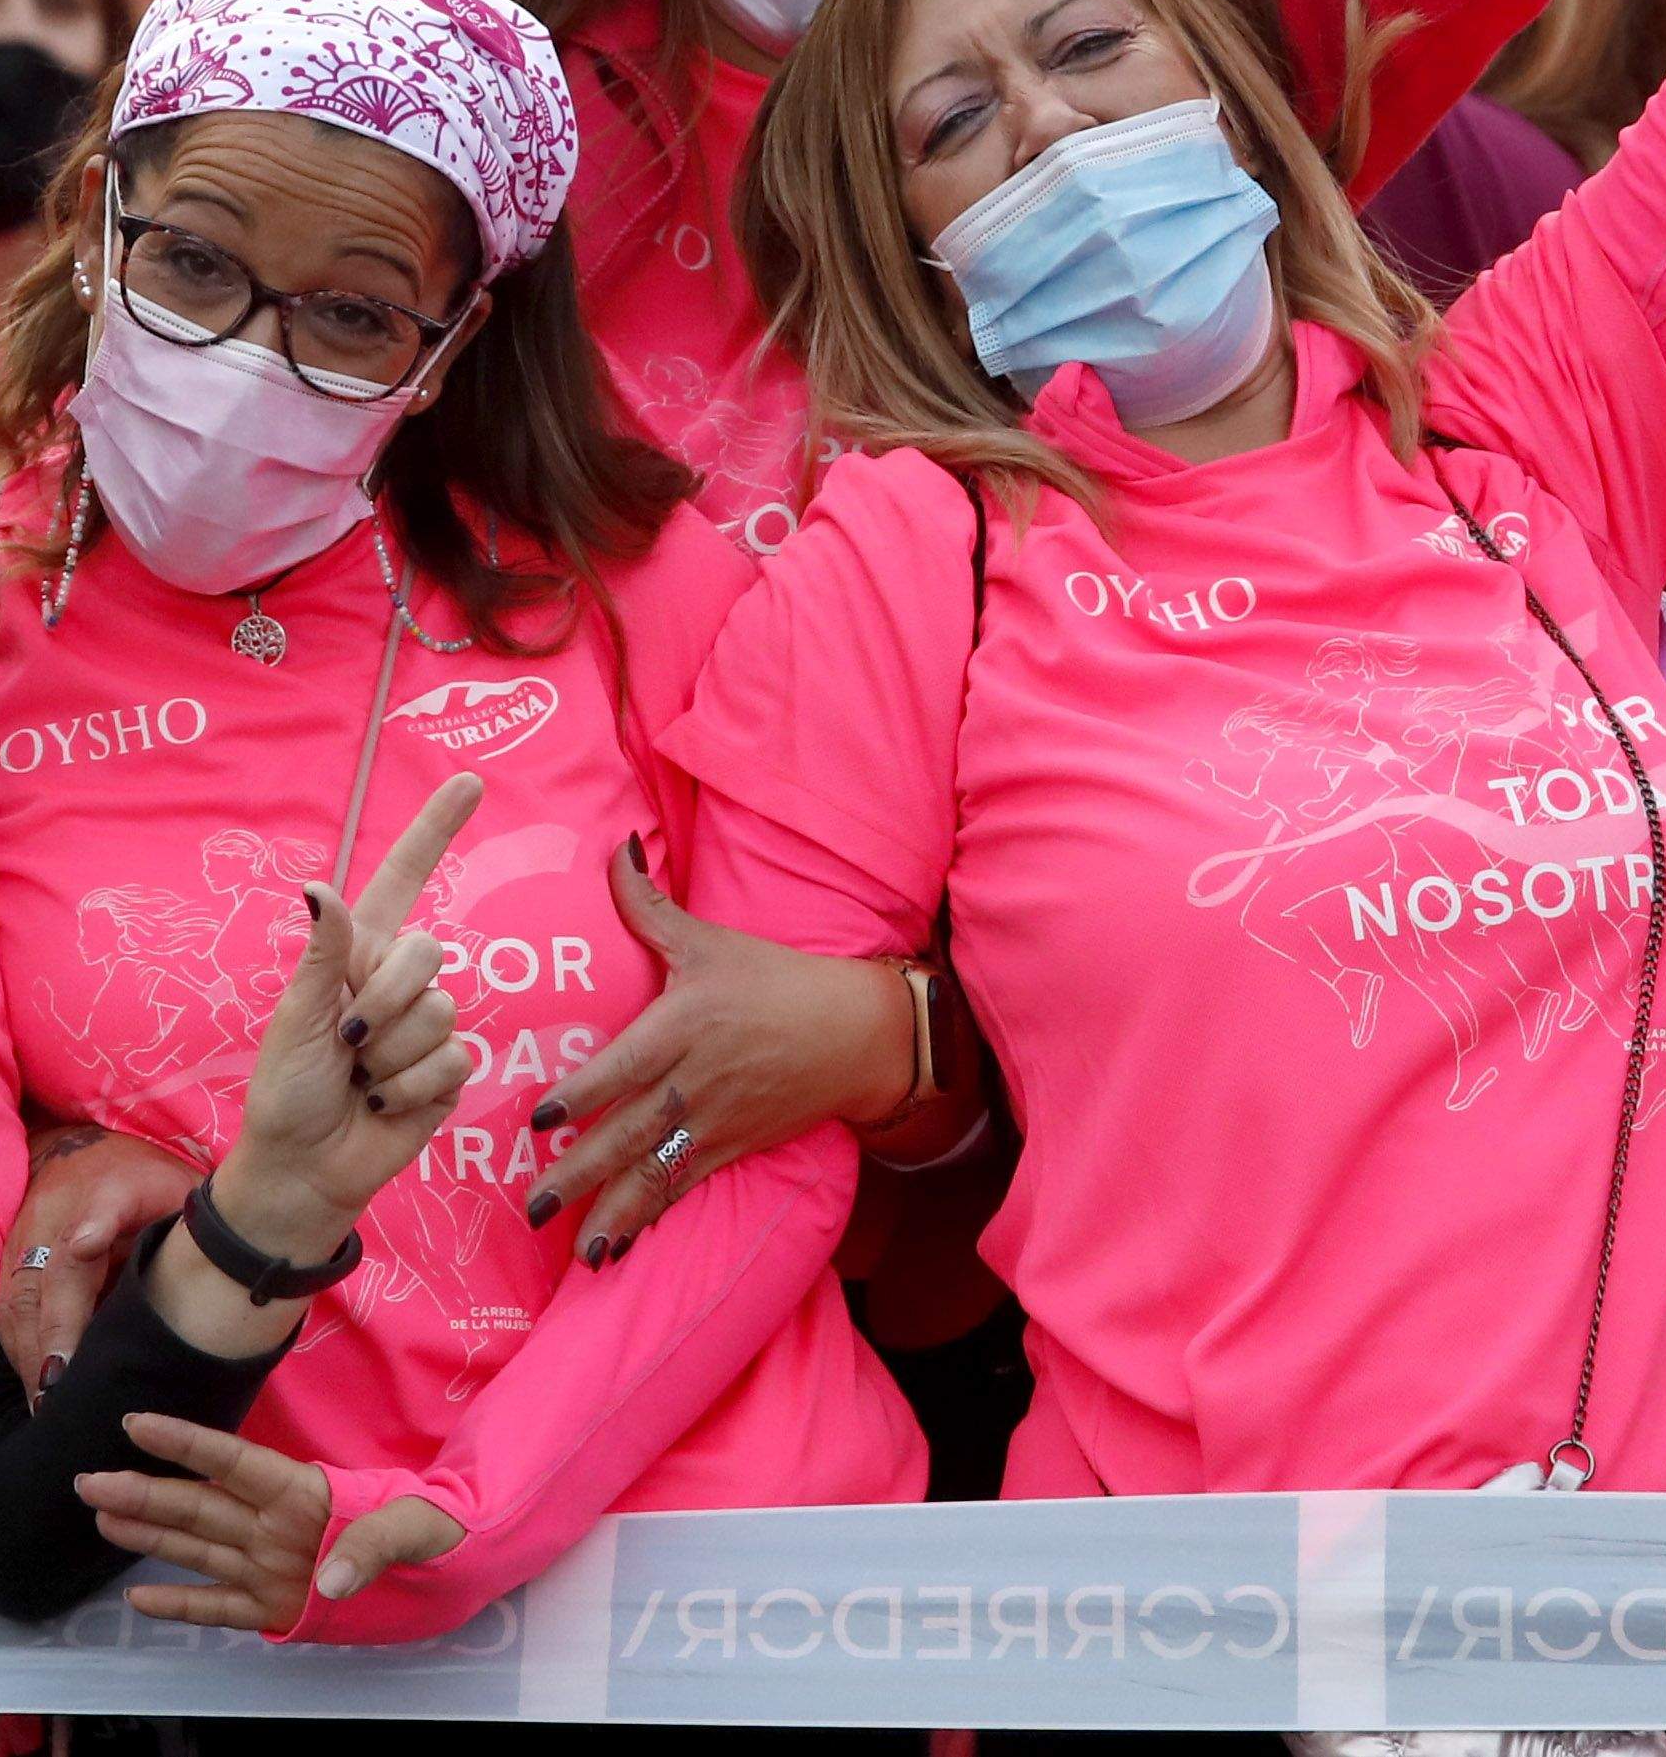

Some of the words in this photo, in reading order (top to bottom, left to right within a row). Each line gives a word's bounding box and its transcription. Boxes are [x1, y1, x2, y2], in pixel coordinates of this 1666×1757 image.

[451, 1027, 595, 1087] DAS
[449, 1319, 468, 1331] DE
[471, 1319, 490, 1331] LA
